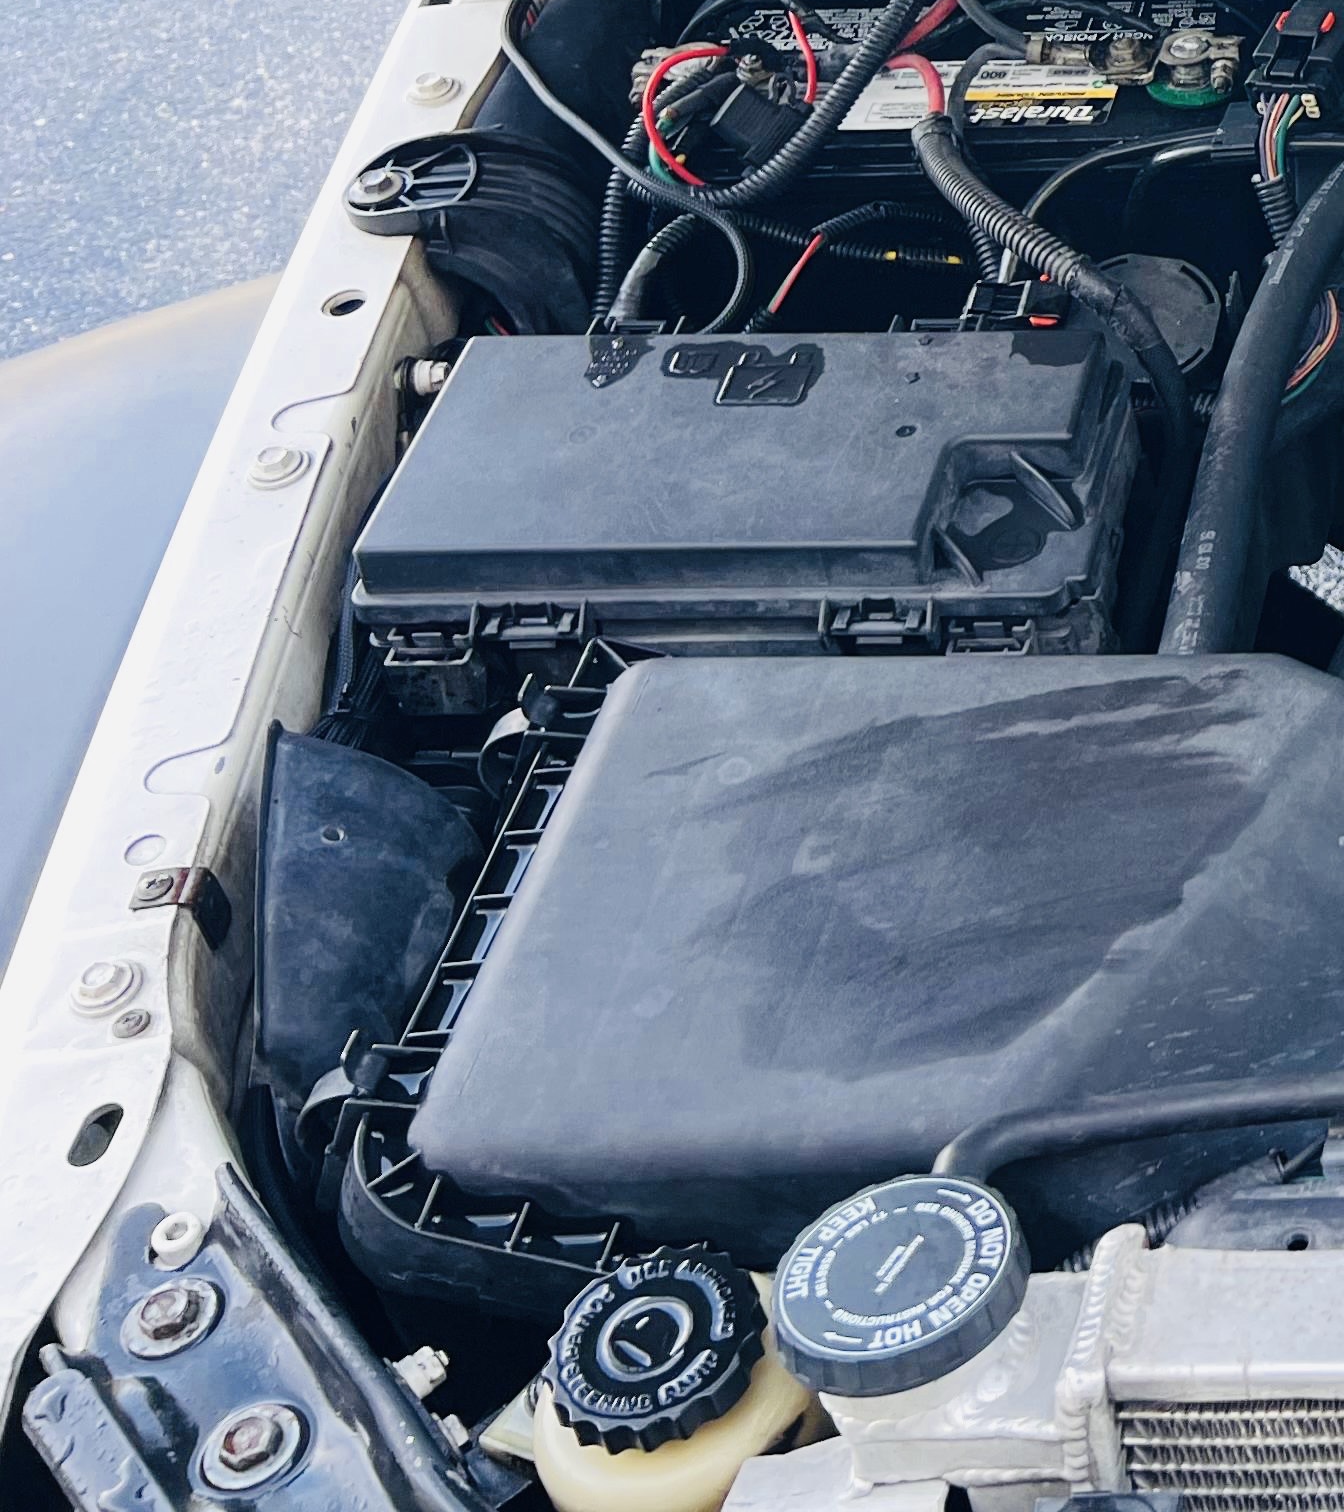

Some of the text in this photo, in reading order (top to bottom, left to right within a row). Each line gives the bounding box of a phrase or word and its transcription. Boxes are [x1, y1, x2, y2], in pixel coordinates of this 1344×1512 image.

[969, 104, 1094, 124] Duralast
[964, 1198, 999, 1227] DO
[785, 1196, 877, 1300] KEEP TIGHT
[976, 1226, 1004, 1270] NOT
[927, 1272, 991, 1329] OPEN
[866, 1319, 922, 1350] HOT
